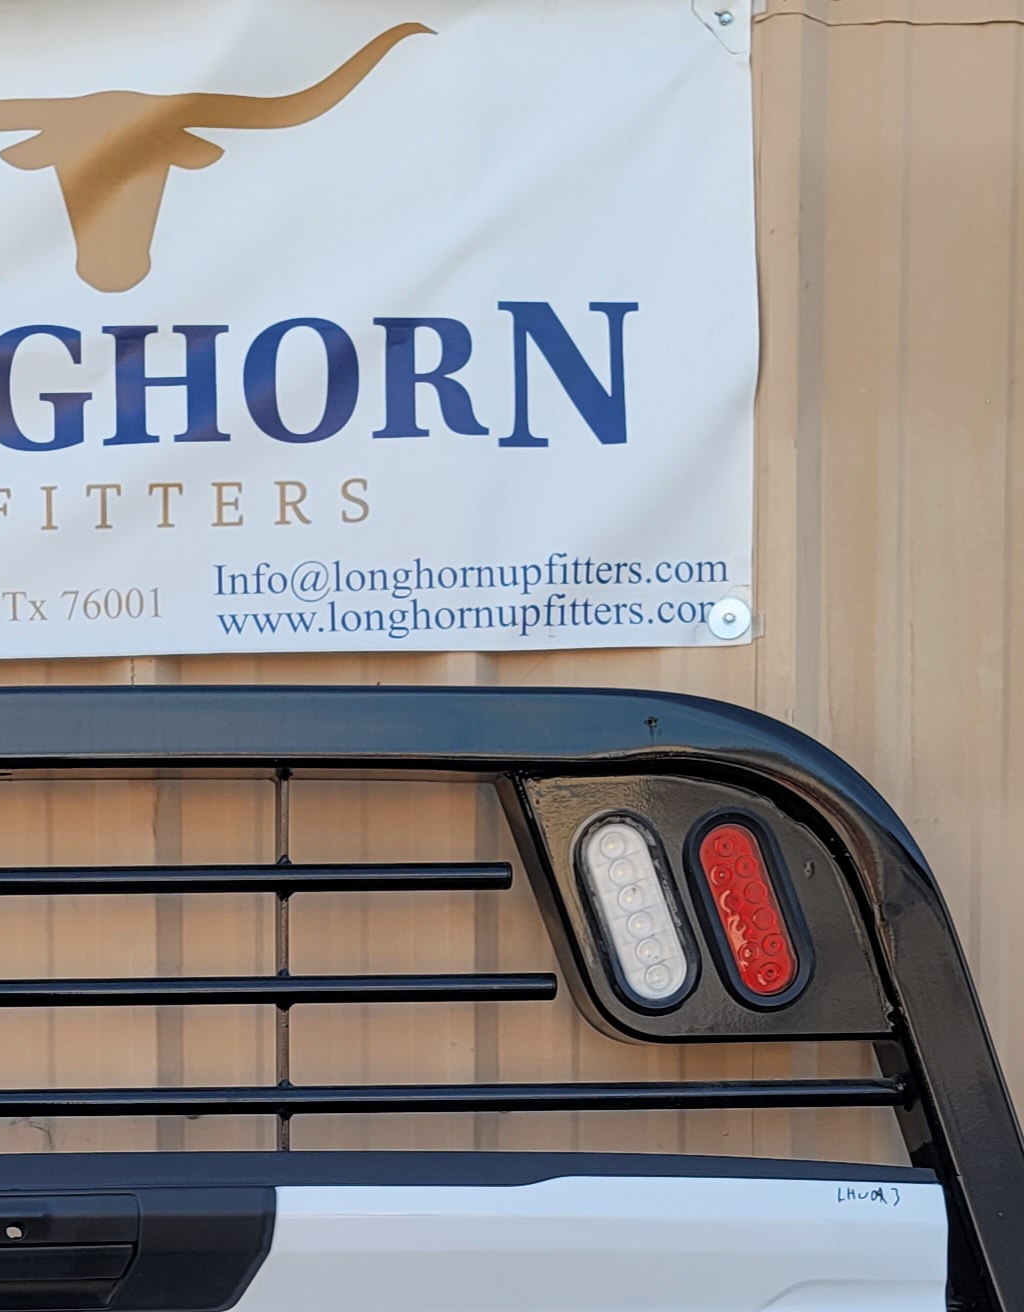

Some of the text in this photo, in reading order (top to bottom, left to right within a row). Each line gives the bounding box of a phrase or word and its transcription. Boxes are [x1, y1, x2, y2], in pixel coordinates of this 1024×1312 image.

[212, 552, 729, 602] Info@longhornupfitters.com
[2, 590, 50, 623] Tx
[60, 587, 163, 622] 76001
